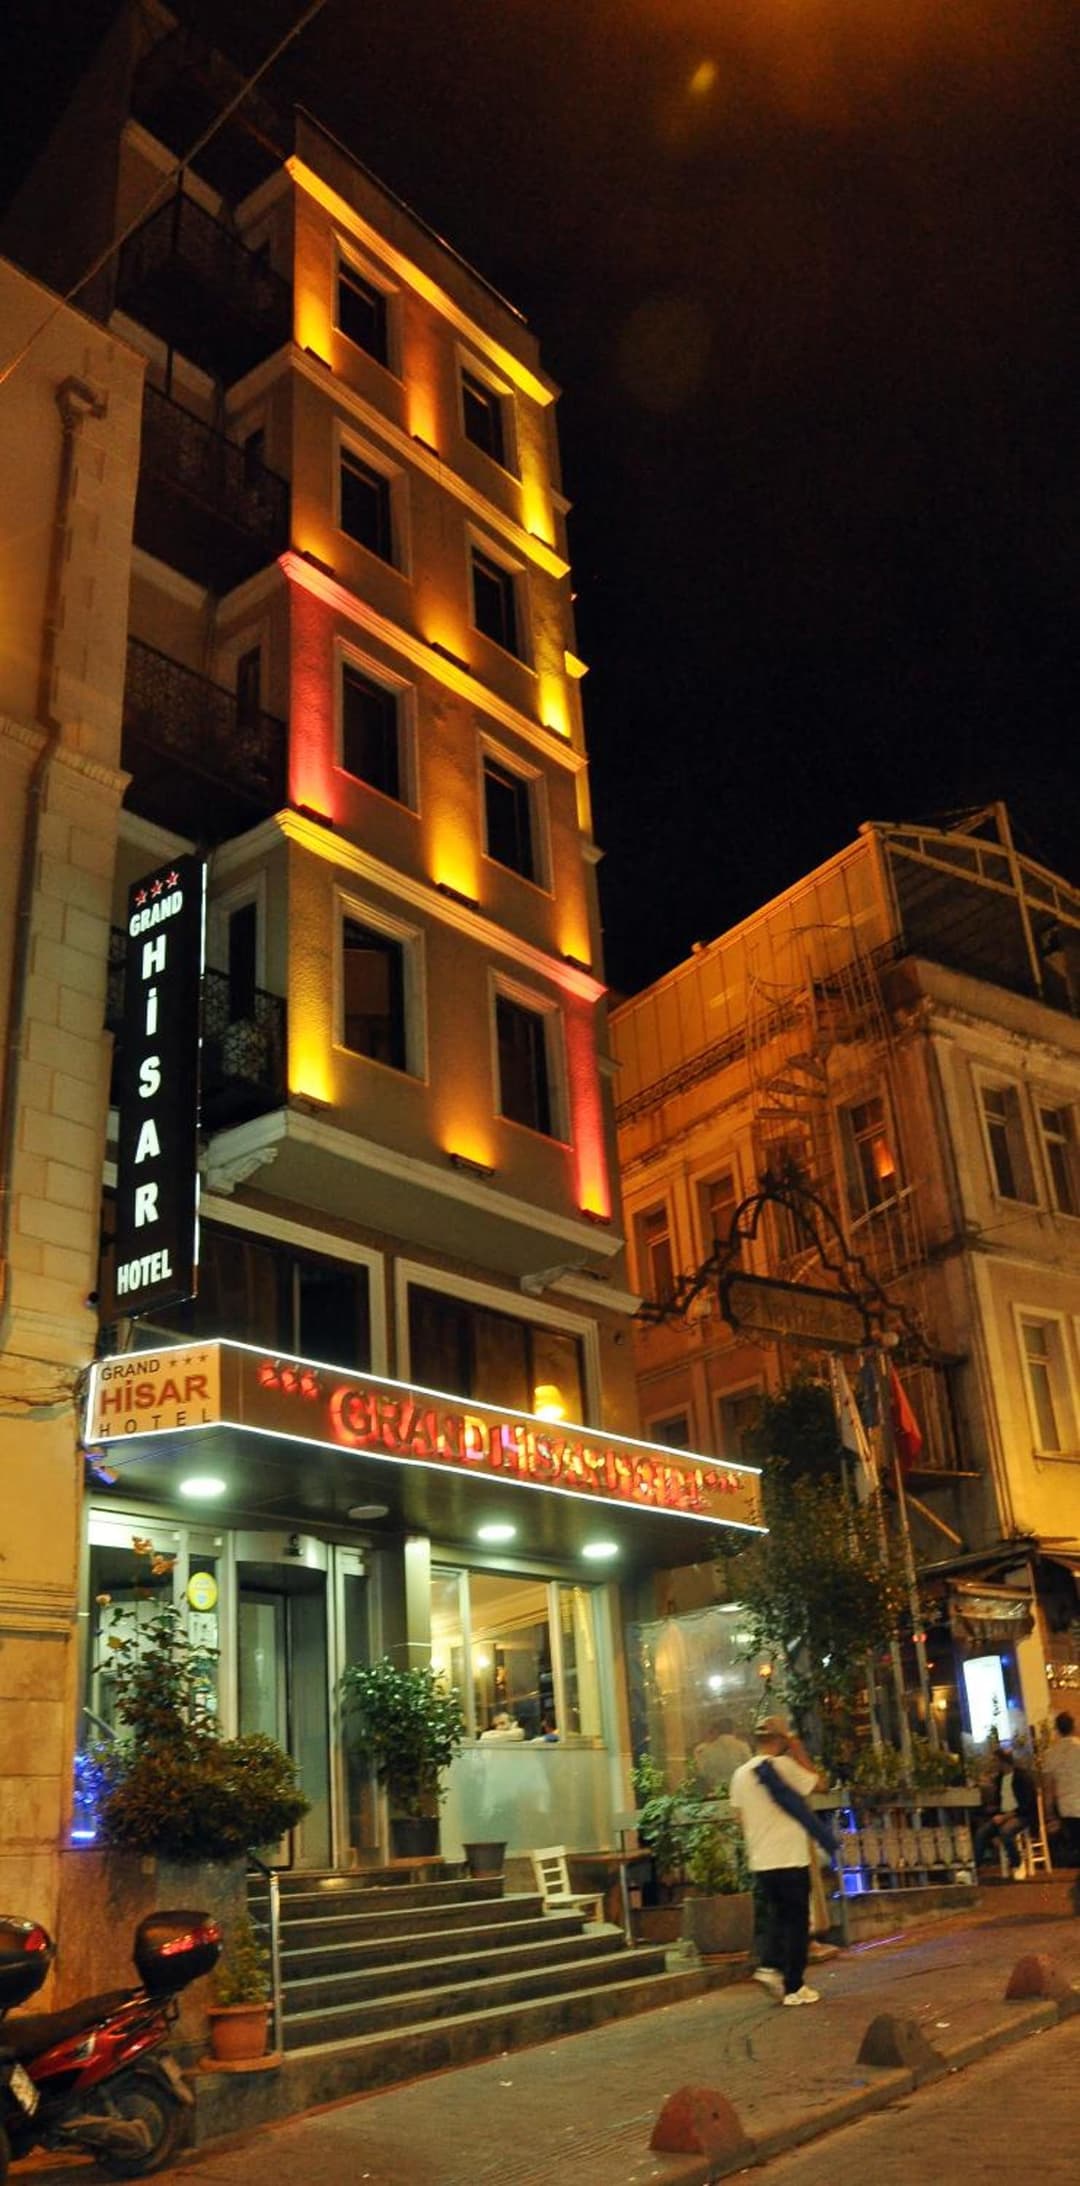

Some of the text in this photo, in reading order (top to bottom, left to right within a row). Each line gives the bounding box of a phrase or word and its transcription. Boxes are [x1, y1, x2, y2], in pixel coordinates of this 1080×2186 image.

[129, 890, 183, 938] GRAND
[117, 1248, 173, 1297] HOTEL
[101, 1359, 160, 1381] GRAND
[99, 1408, 211, 1437] HOTEL
[330, 1386, 489, 1461] GRAND
